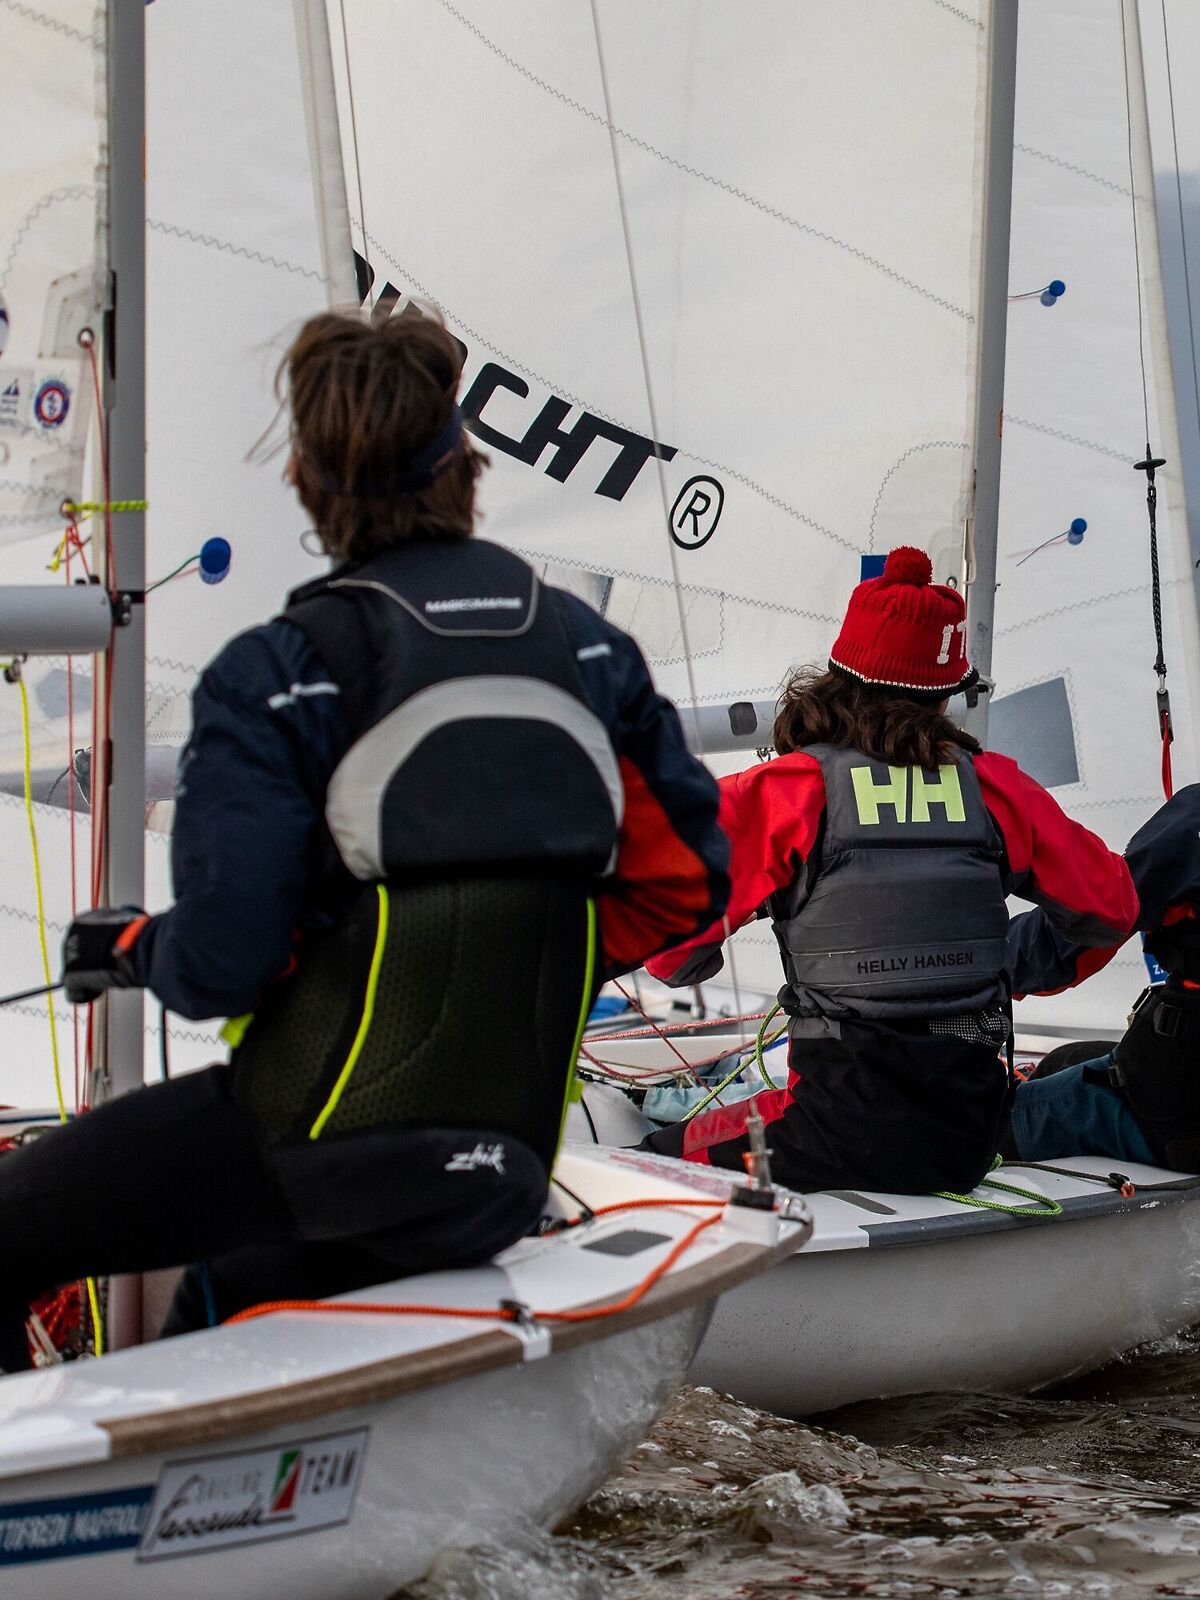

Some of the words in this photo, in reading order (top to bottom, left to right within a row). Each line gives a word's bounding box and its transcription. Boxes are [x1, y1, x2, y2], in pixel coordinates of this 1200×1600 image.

[850, 764, 967, 825] HH
[857, 957, 909, 974] HELLY
[914, 951, 974, 970] HANSEN
[300, 1448, 359, 1495] TEAM
